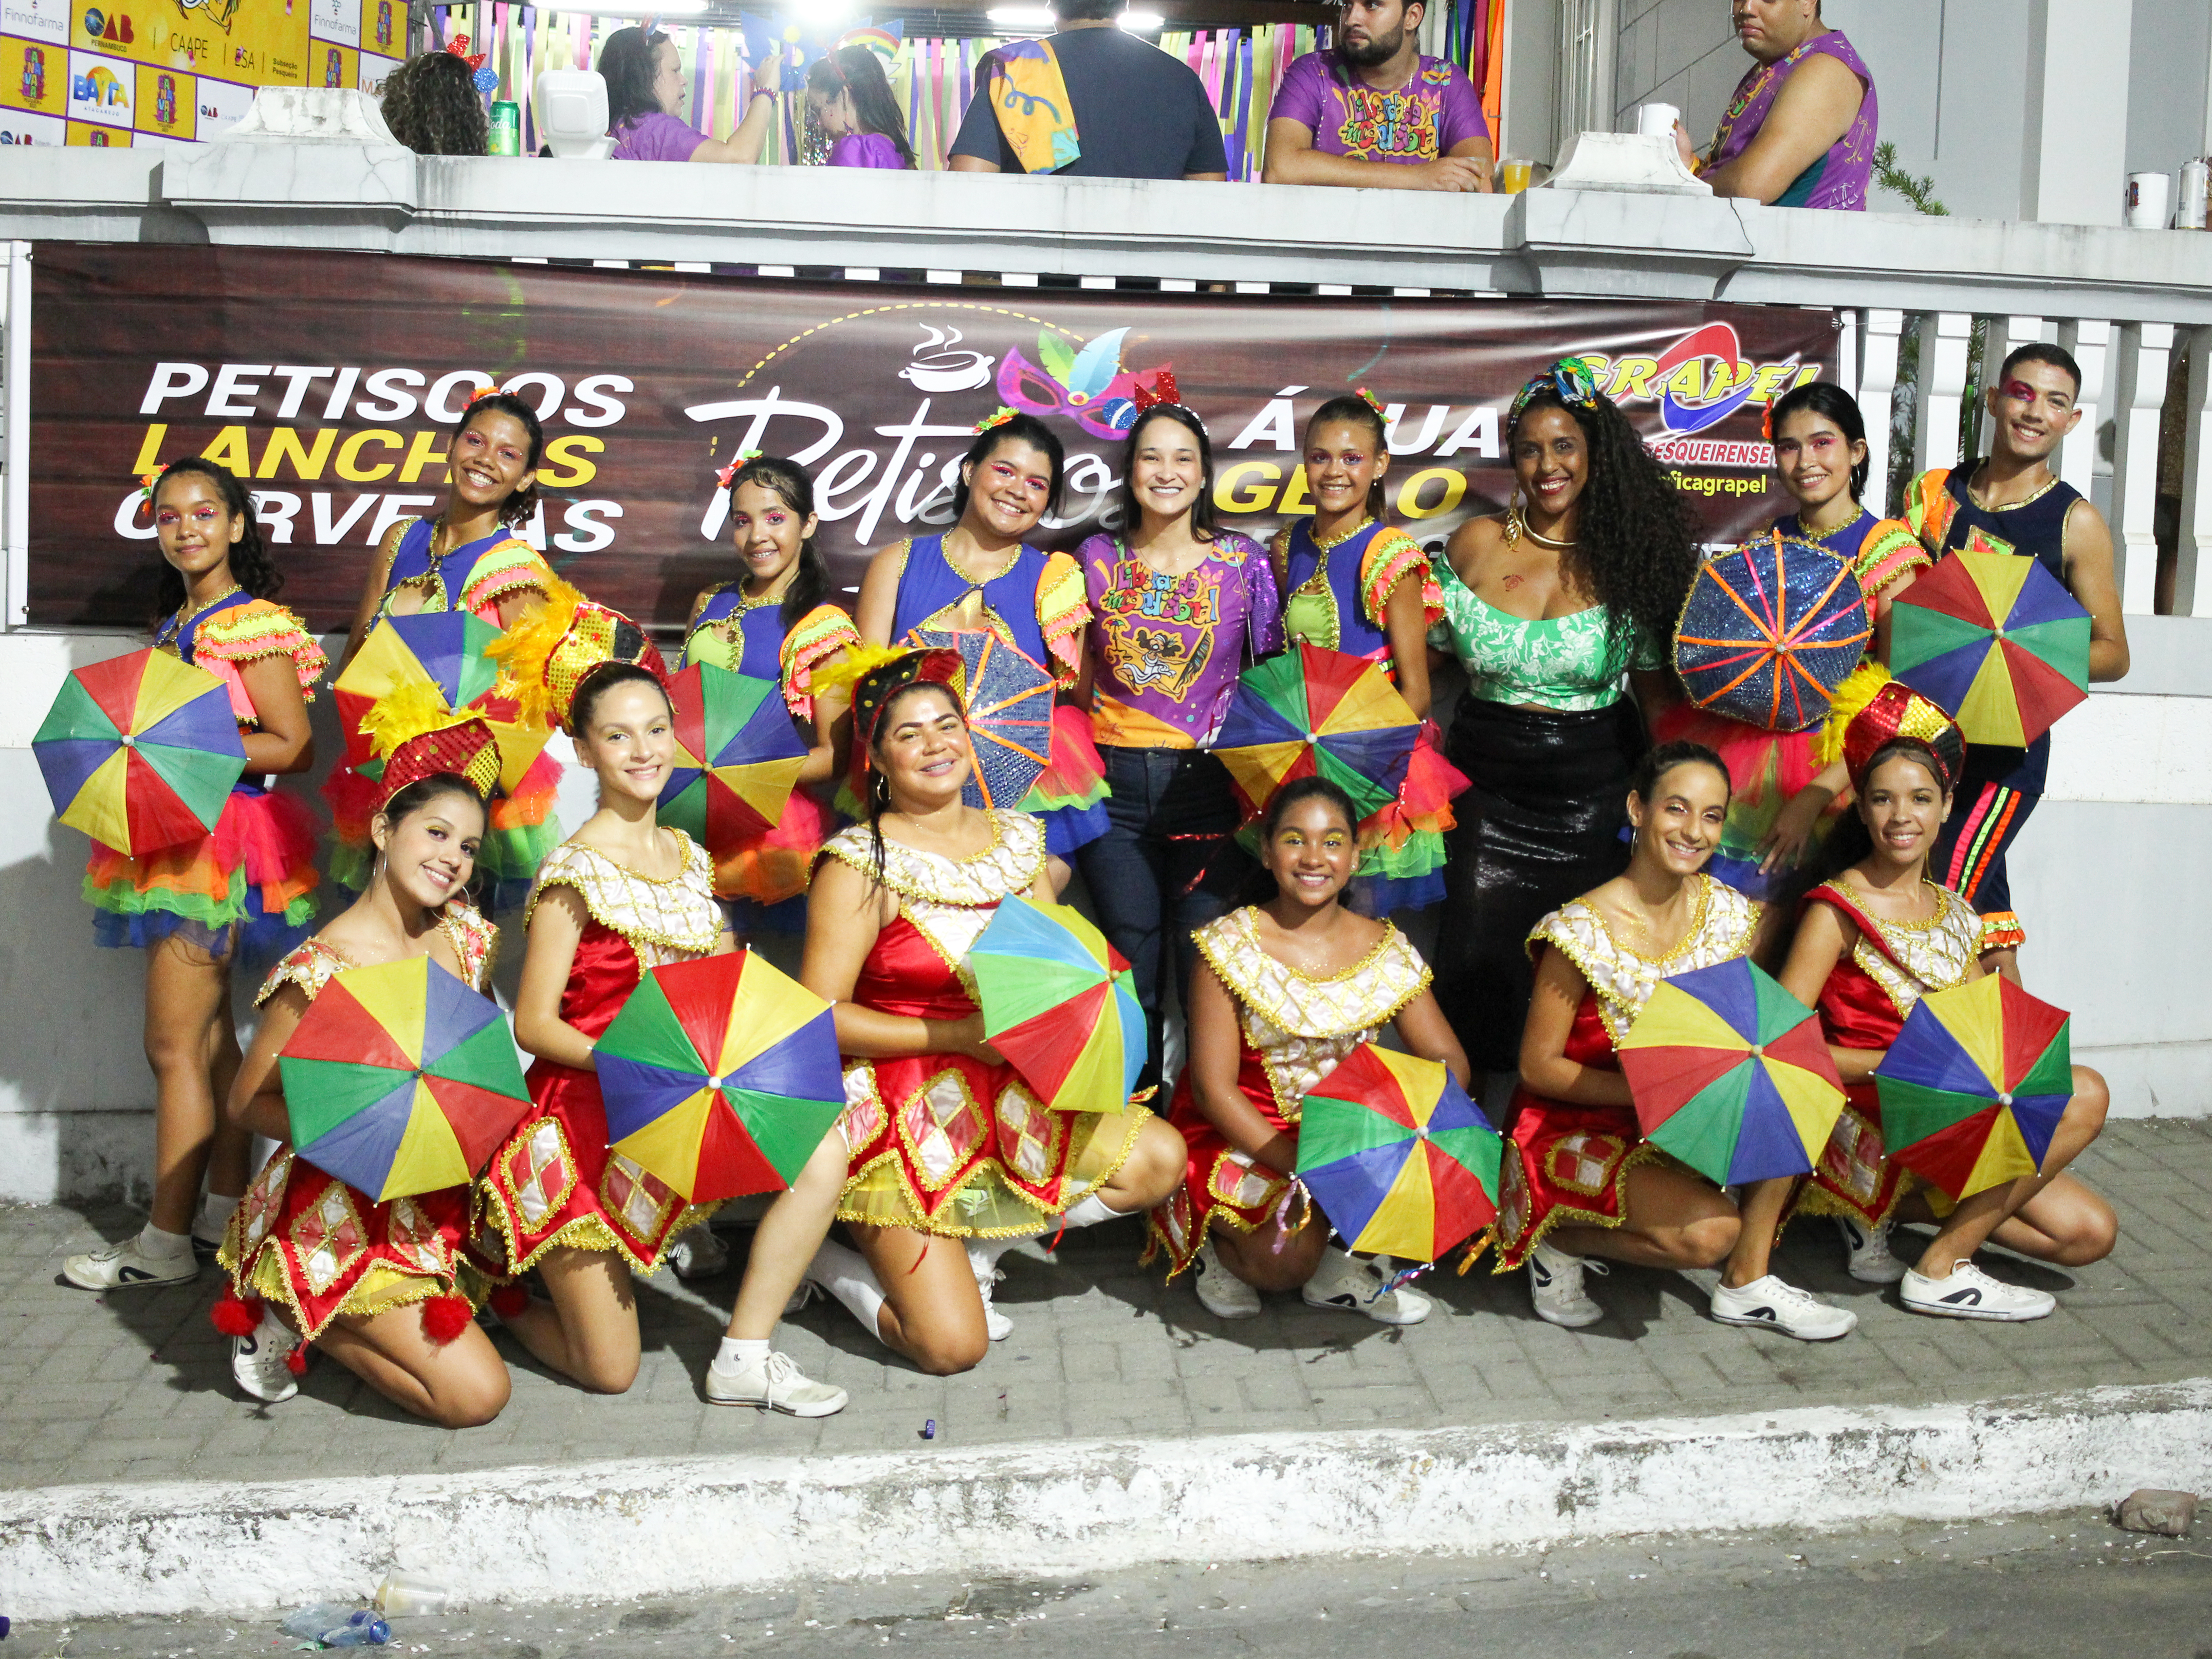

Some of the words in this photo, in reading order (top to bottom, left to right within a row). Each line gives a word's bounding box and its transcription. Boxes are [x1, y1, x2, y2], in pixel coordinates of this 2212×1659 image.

[5, 7, 64, 31] Finnofarma
[314, 14, 357, 35] Finnofarma
[170, 33, 208, 58] CAAPE
[235, 48, 255, 70] ESA
[139, 362, 634, 427] PETISCOS
[1227, 386, 1500, 459] ÁUA
[132, 424, 606, 488] LANCHS
[1655, 442, 1771, 464] ESQUEIRENSE
[1213, 461, 1468, 519] GEO
[1670, 470, 1767, 497] ficagrapel
[114, 489, 624, 553] CRVEAS
